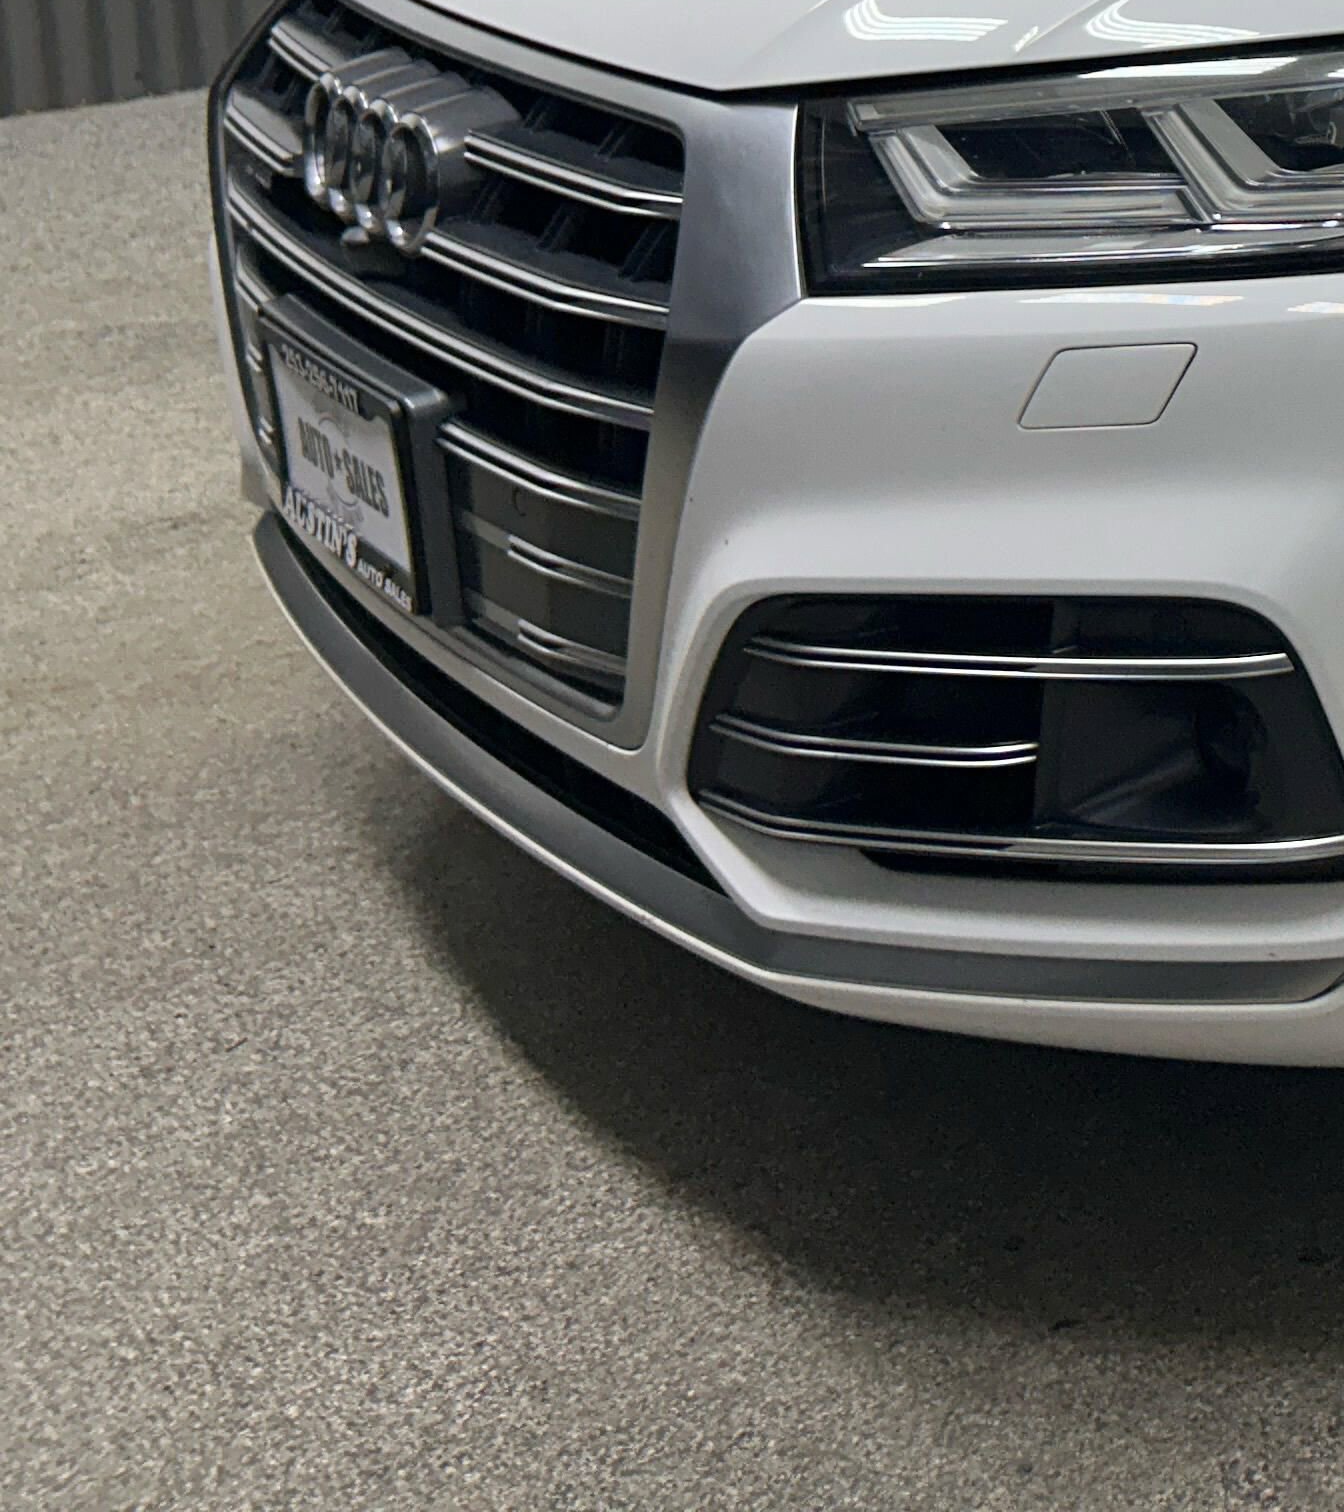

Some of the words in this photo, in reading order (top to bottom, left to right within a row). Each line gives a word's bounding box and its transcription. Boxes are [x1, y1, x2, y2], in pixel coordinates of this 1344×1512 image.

[297, 417, 335, 479] AUTO
[343, 448, 390, 519] SALES
[283, 484, 359, 569] AUSTIN'S
[357, 558, 384, 589] AUTO
[384, 576, 413, 613] SALES
